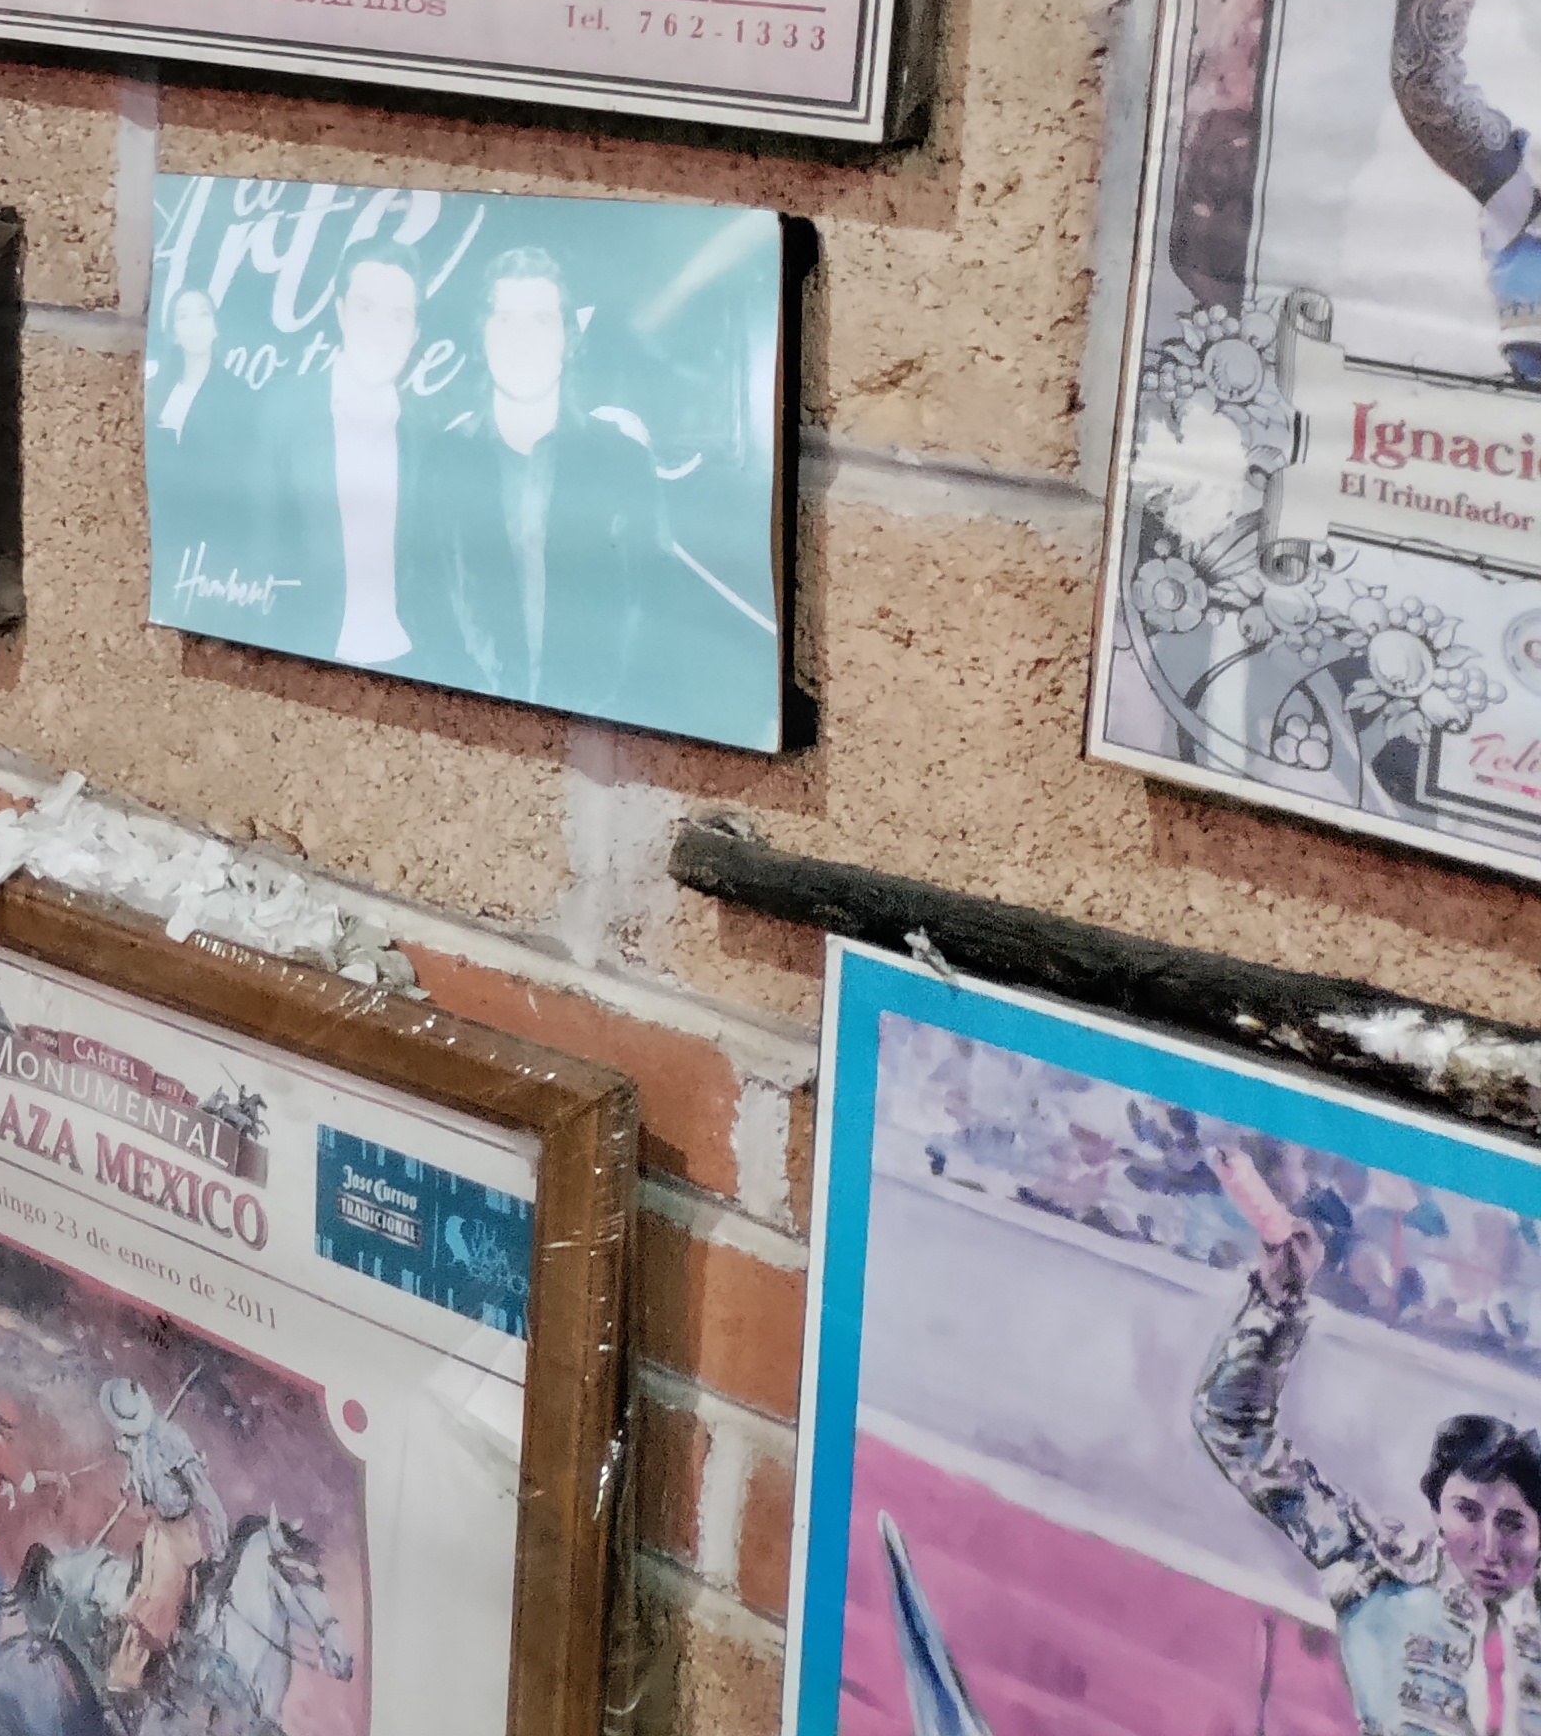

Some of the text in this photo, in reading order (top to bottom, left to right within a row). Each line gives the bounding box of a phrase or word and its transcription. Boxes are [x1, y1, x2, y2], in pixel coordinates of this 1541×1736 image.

[563, 3, 611, 33] Tel.
[1345, 400, 1541, 481] Ignaci
[1339, 470, 1536, 533] El Triunfador
[71, 1036, 140, 1083] CARTEL
[94, 1130, 269, 1253] MEXICO
[339, 1196, 418, 1242] TRADICIONAL
[53, 1210, 79, 1240] 23
[85, 1227, 112, 1255] de
[117, 1244, 182, 1286] enero
[188, 1273, 216, 1301] de
[223, 1287, 279, 1330] 2011
